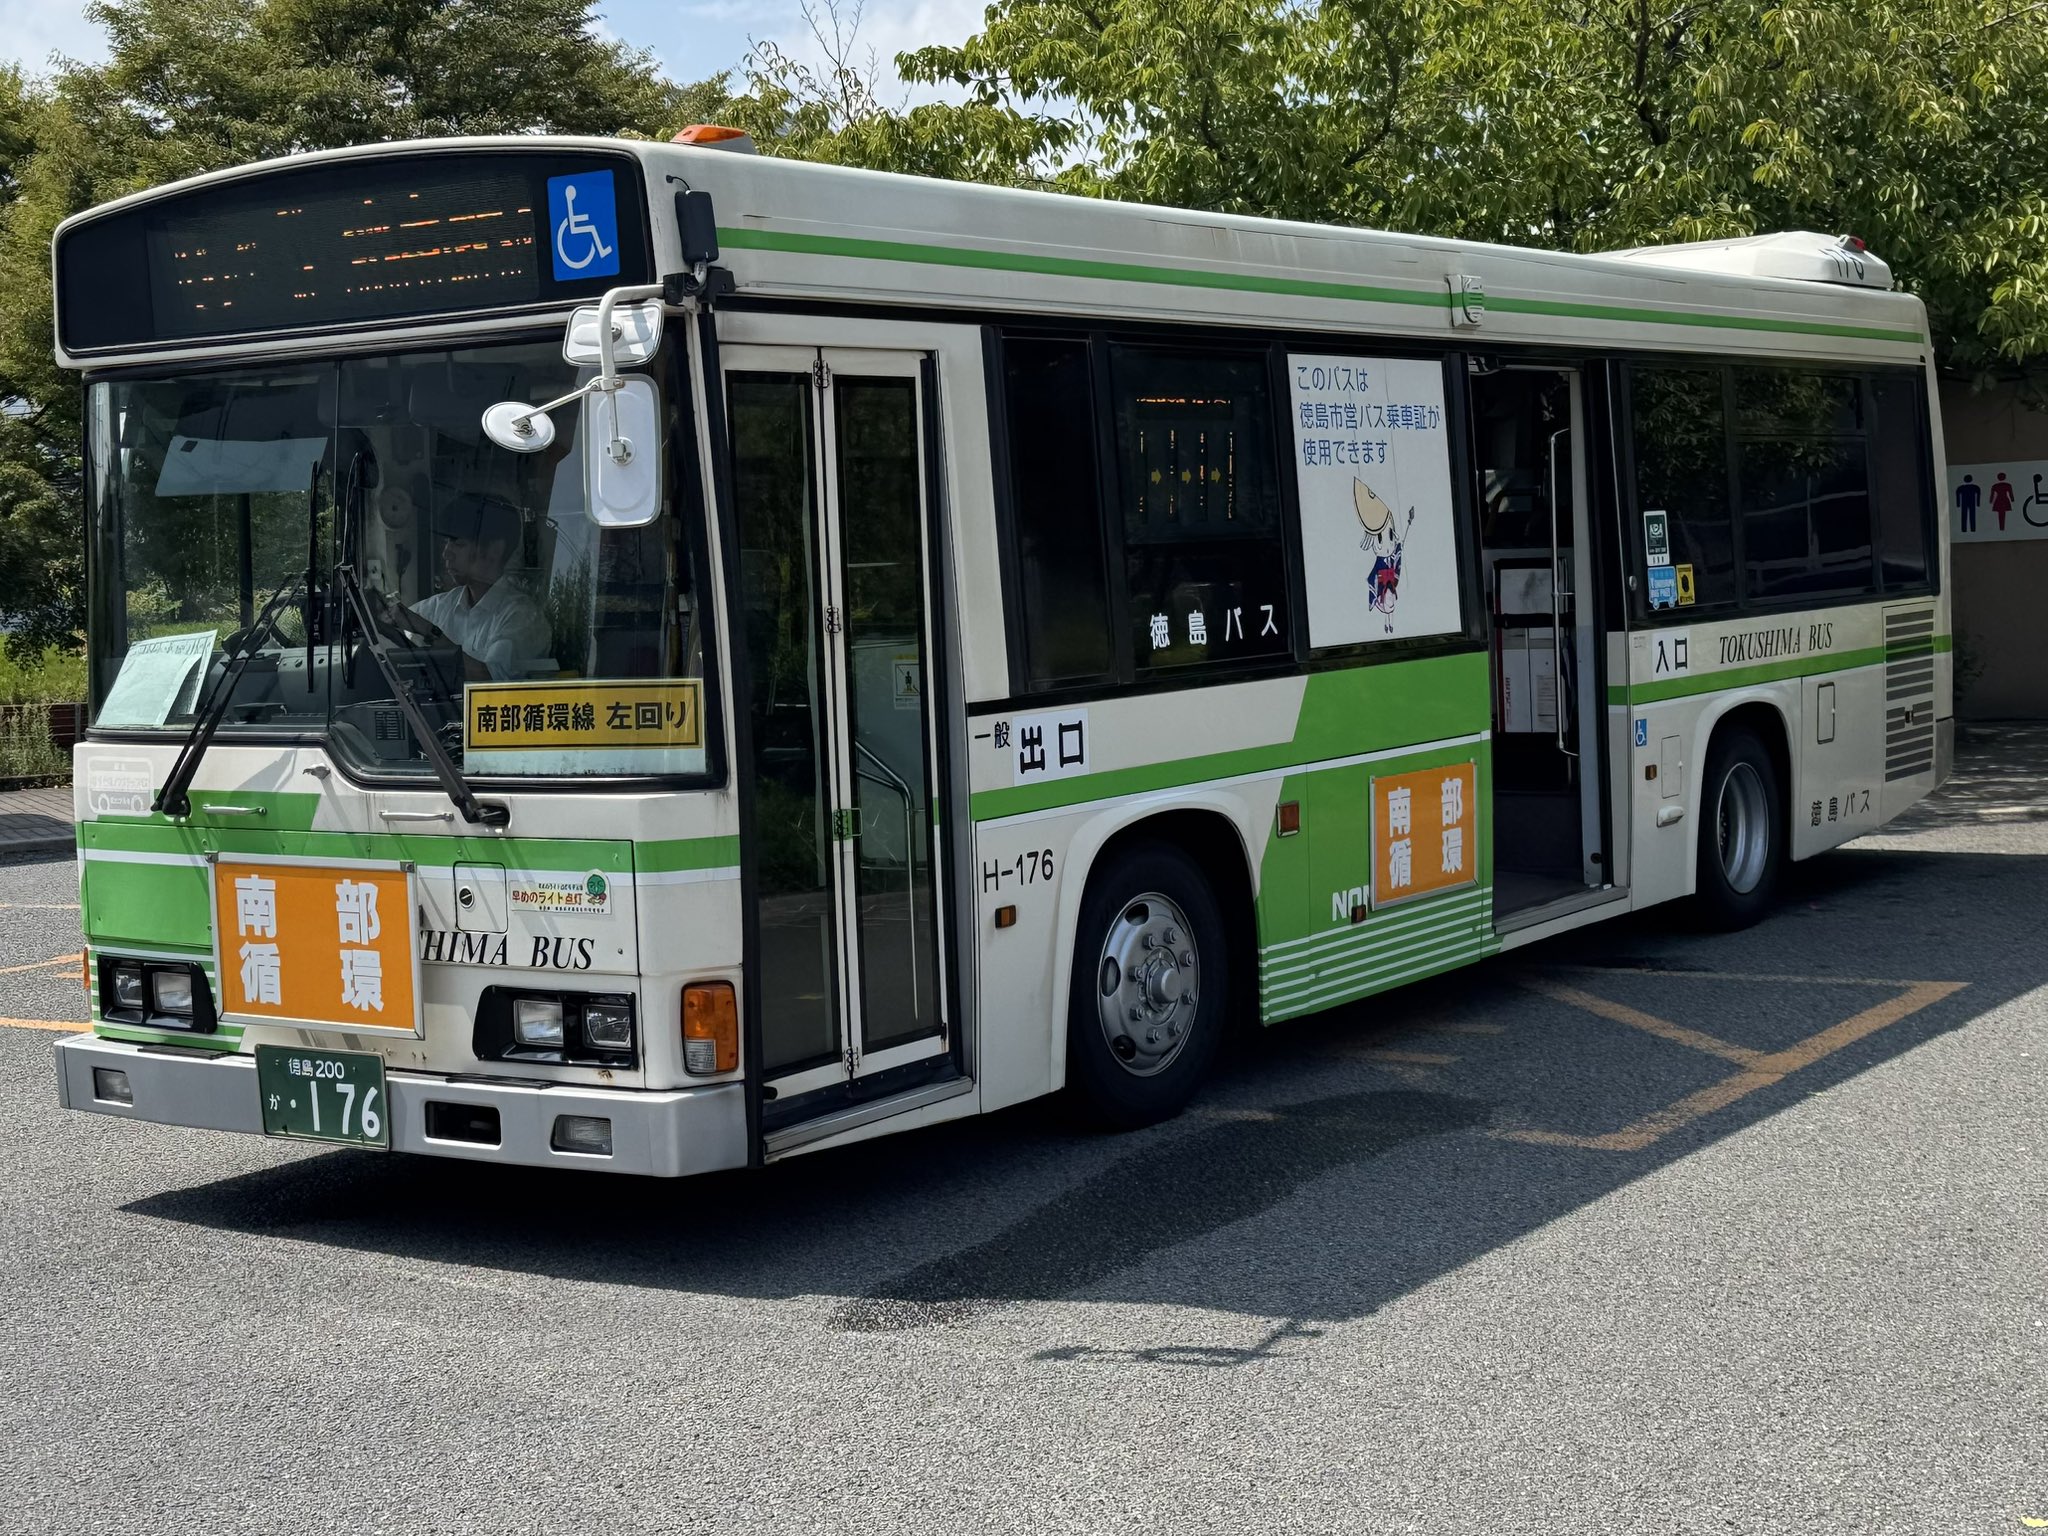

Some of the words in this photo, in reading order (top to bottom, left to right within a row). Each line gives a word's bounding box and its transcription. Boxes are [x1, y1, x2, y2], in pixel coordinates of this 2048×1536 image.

[1296, 365, 1369, 392] このバスは
[1299, 402, 1441, 431] 徳島市営バス乗車証が
[1303, 438, 1388, 466] 使用できます
[1149, 604, 1279, 651] 徳島バス
[1719, 626, 1802, 664] TOKUSHIMA
[1808, 622, 1833, 651] BUS
[1655, 636, 1688, 674] 入口
[477, 702, 596, 733] 南部循環線
[605, 701, 689, 731] 左回り
[974, 720, 1011, 749] 一般
[1018, 719, 1086, 775] 出口
[983, 848, 1055, 894] H-176
[512, 890, 583, 906] 早めのライト点灯
[529, 935, 595, 970] BUS
